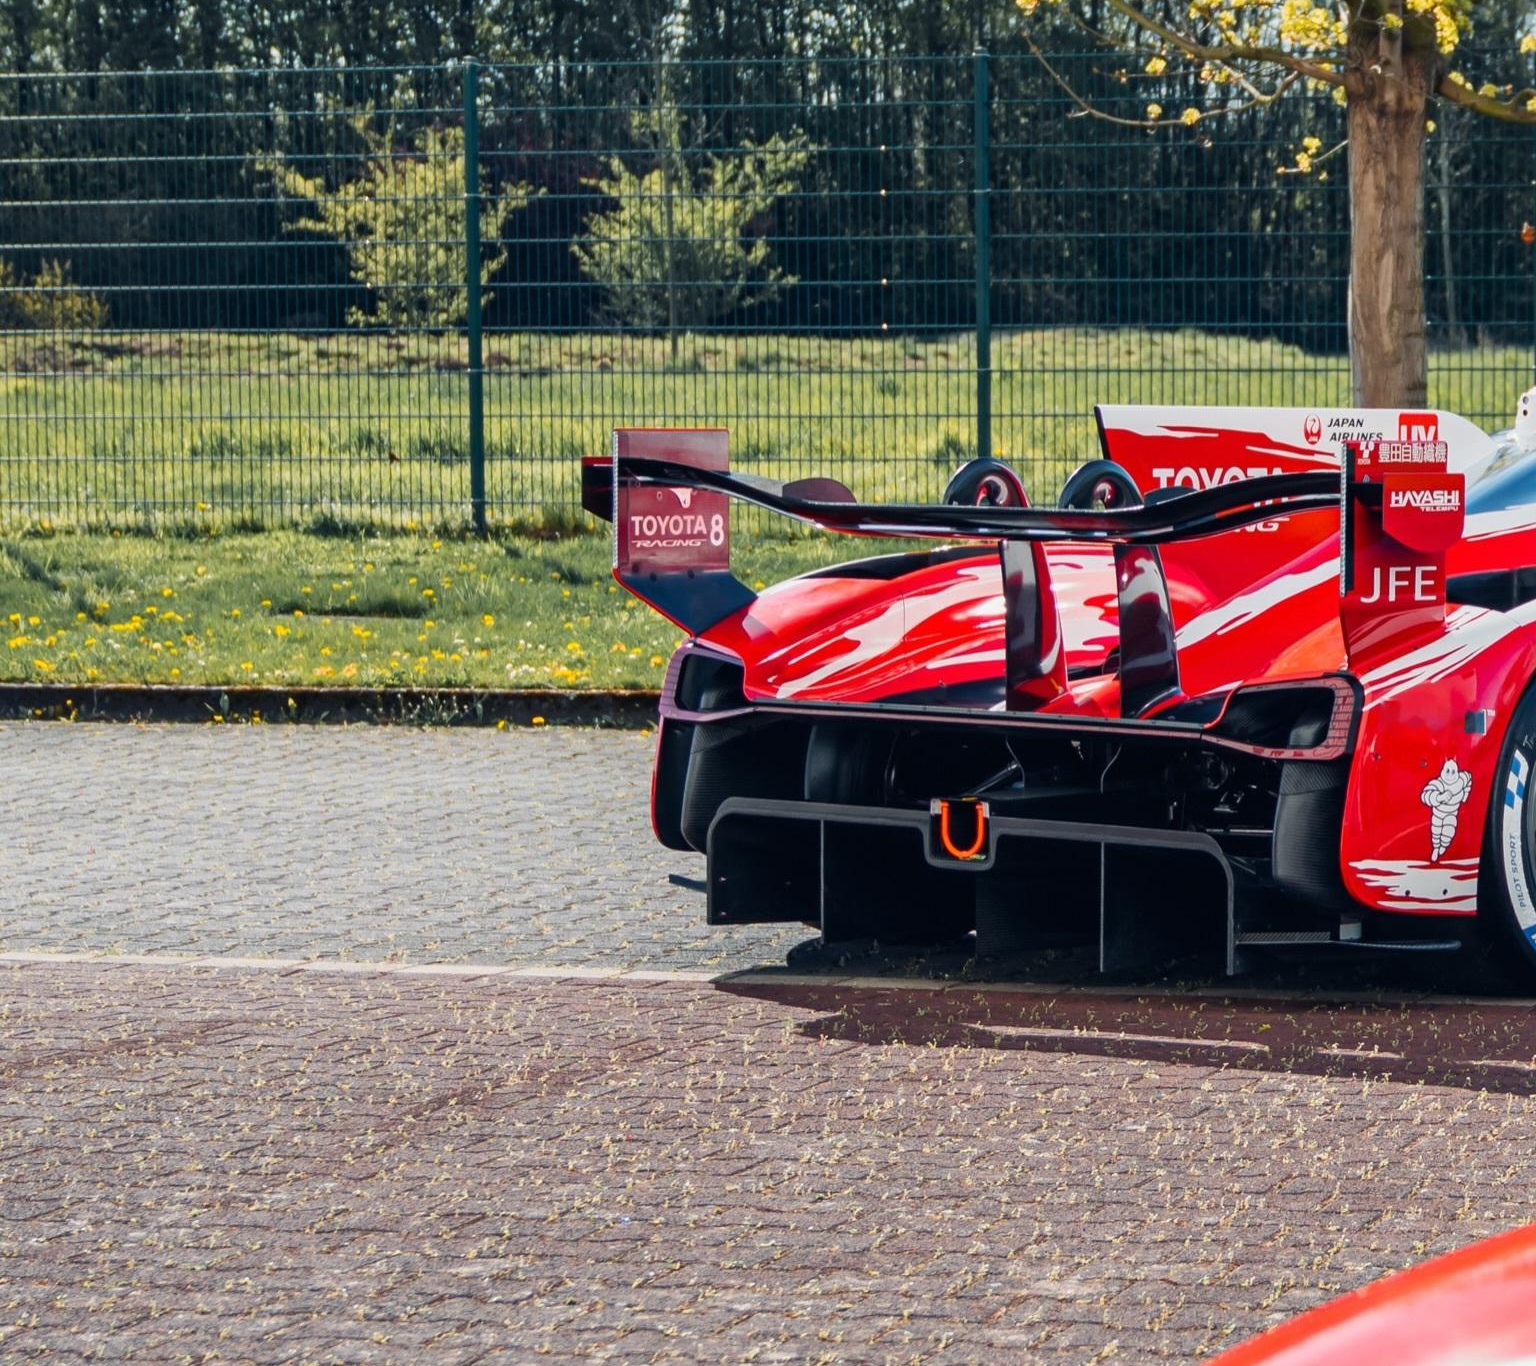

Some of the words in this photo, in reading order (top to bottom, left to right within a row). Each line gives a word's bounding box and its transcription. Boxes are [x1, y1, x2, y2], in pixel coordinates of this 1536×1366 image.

[1327, 418, 1364, 428] JAPAN
[1329, 432, 1383, 441] AIRLINES
[1389, 490, 1461, 508] HAYASHI
[630, 514, 707, 536] TOYOTA
[710, 513, 725, 547] 8
[631, 538, 708, 548] RACING
[1360, 566, 1437, 604] JFE
[1509, 835, 1519, 875] SPORT
[1513, 877, 1527, 908] PILOT
